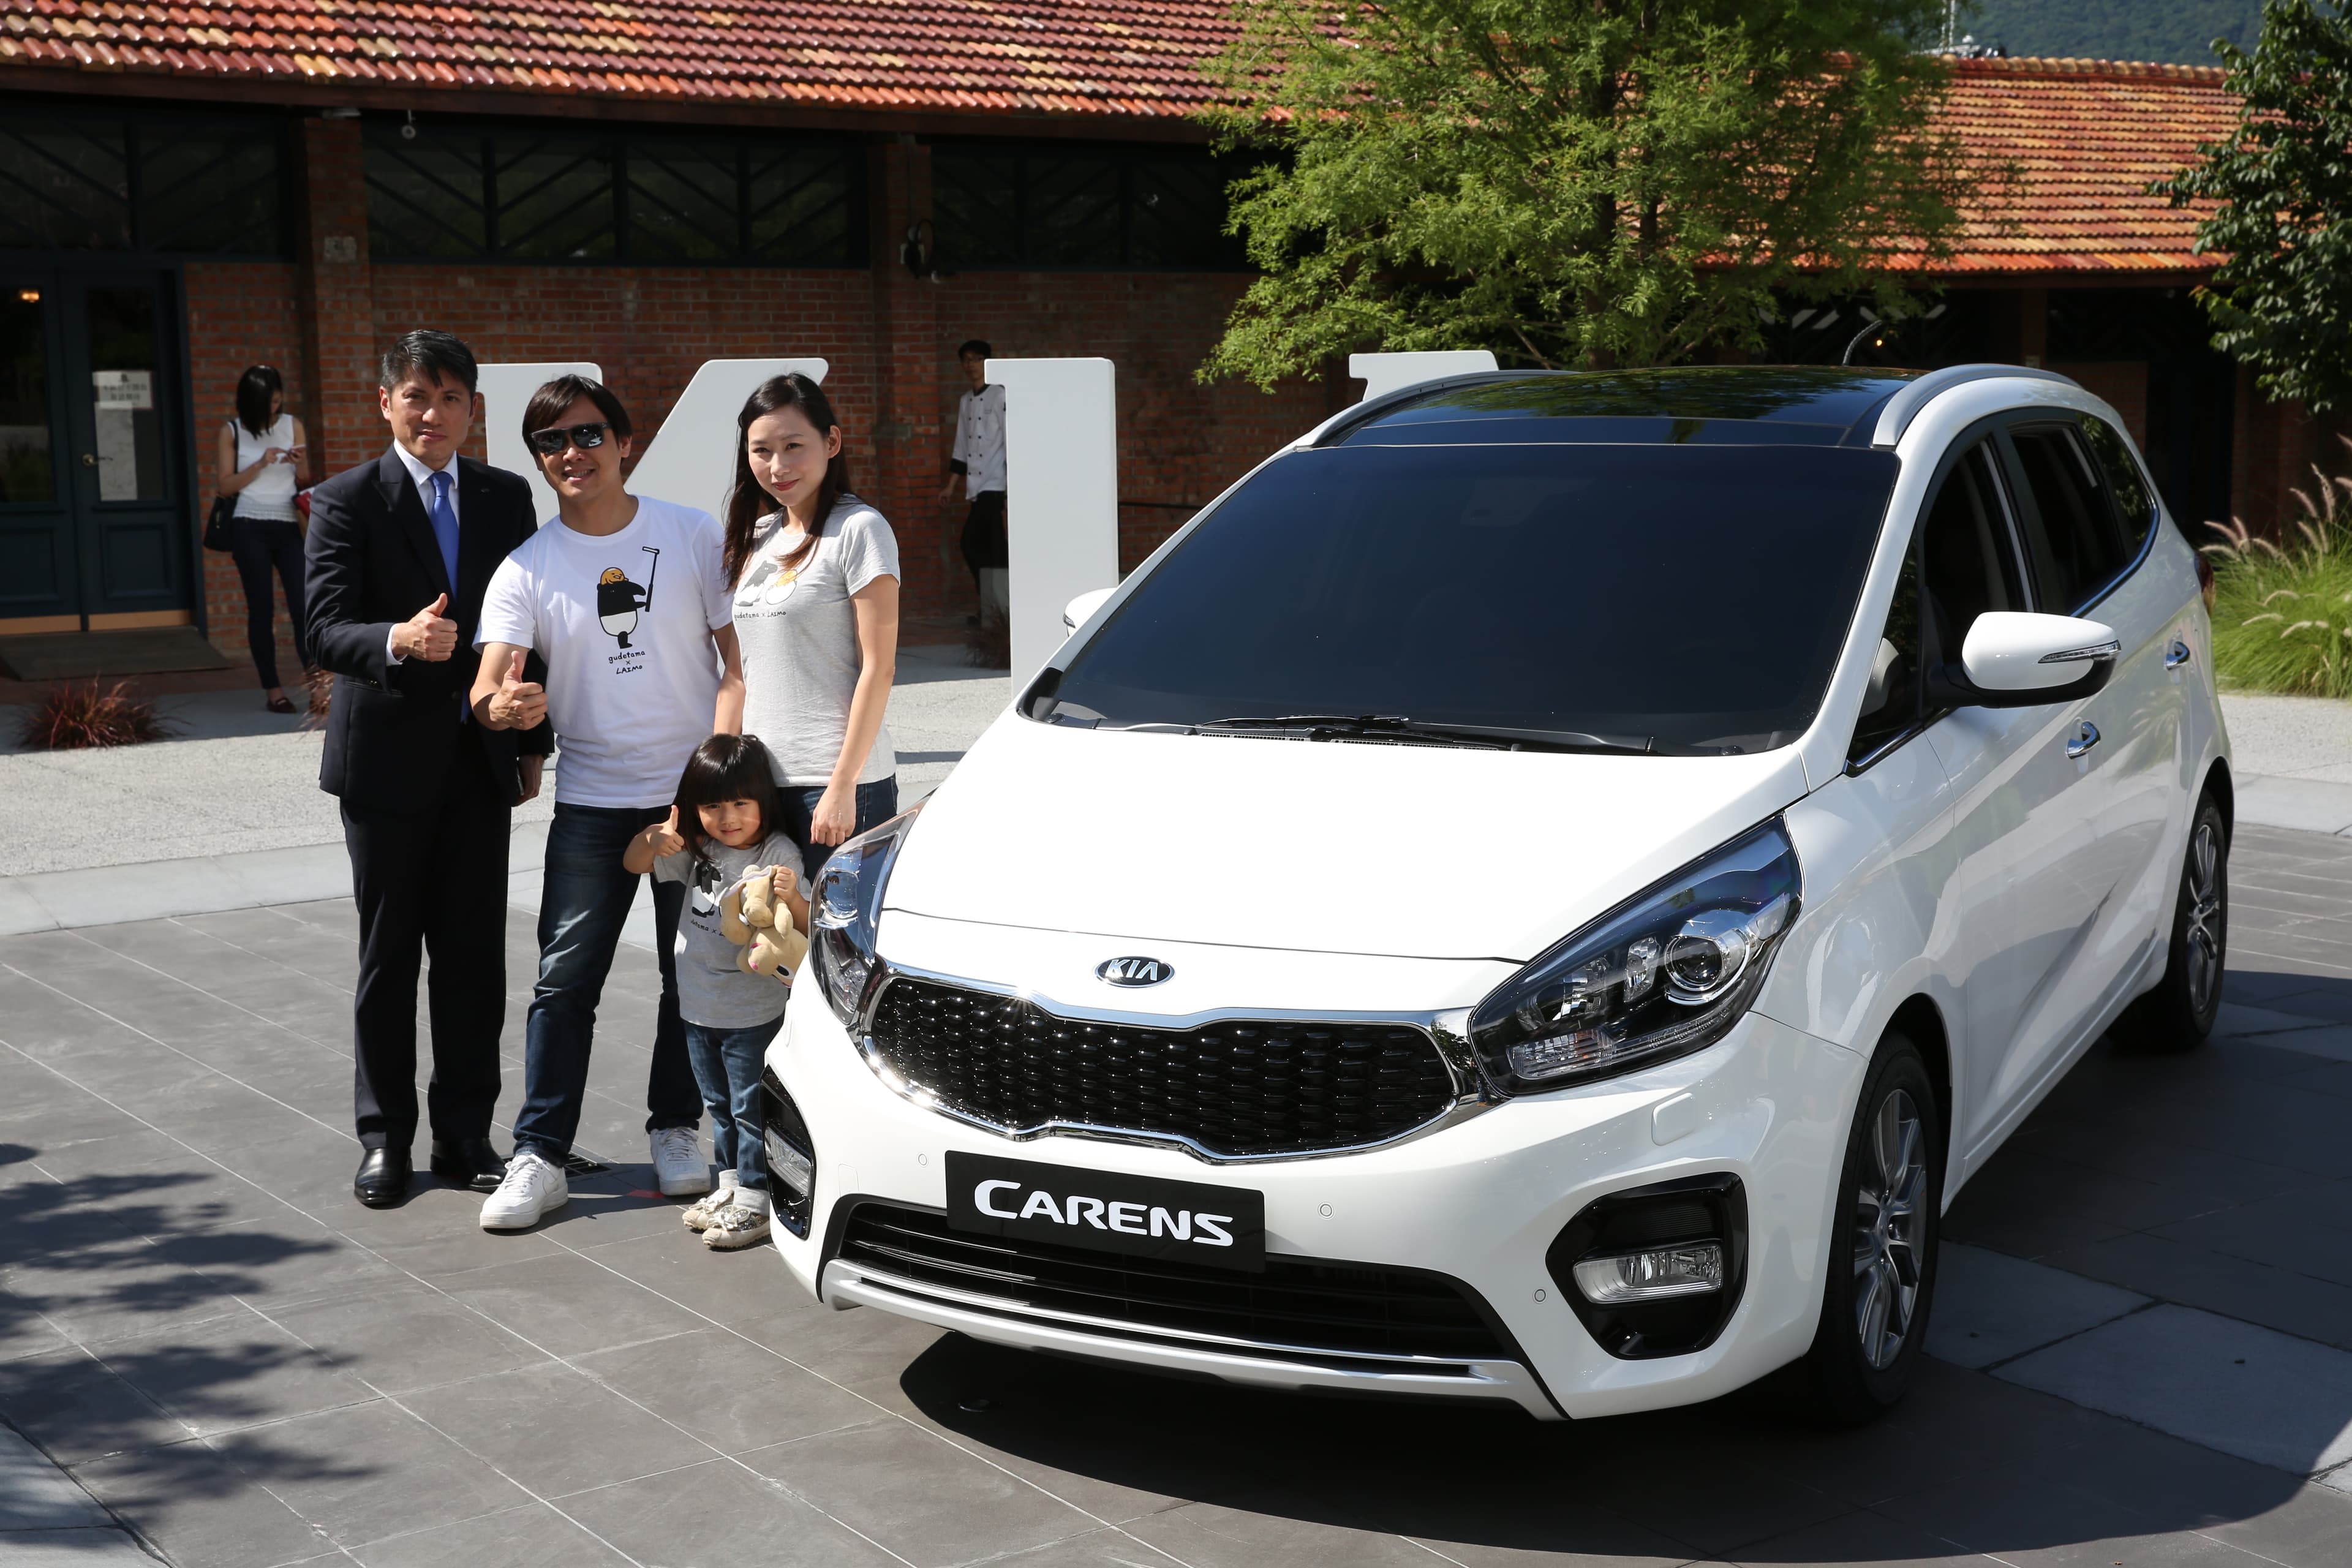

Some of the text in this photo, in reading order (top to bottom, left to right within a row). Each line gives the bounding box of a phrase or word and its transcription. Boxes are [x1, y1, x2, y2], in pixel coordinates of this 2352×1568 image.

[608, 650, 646, 664] gudetama
[1105, 959, 1158, 981] KIA
[974, 1179, 1234, 1246] CARENS
